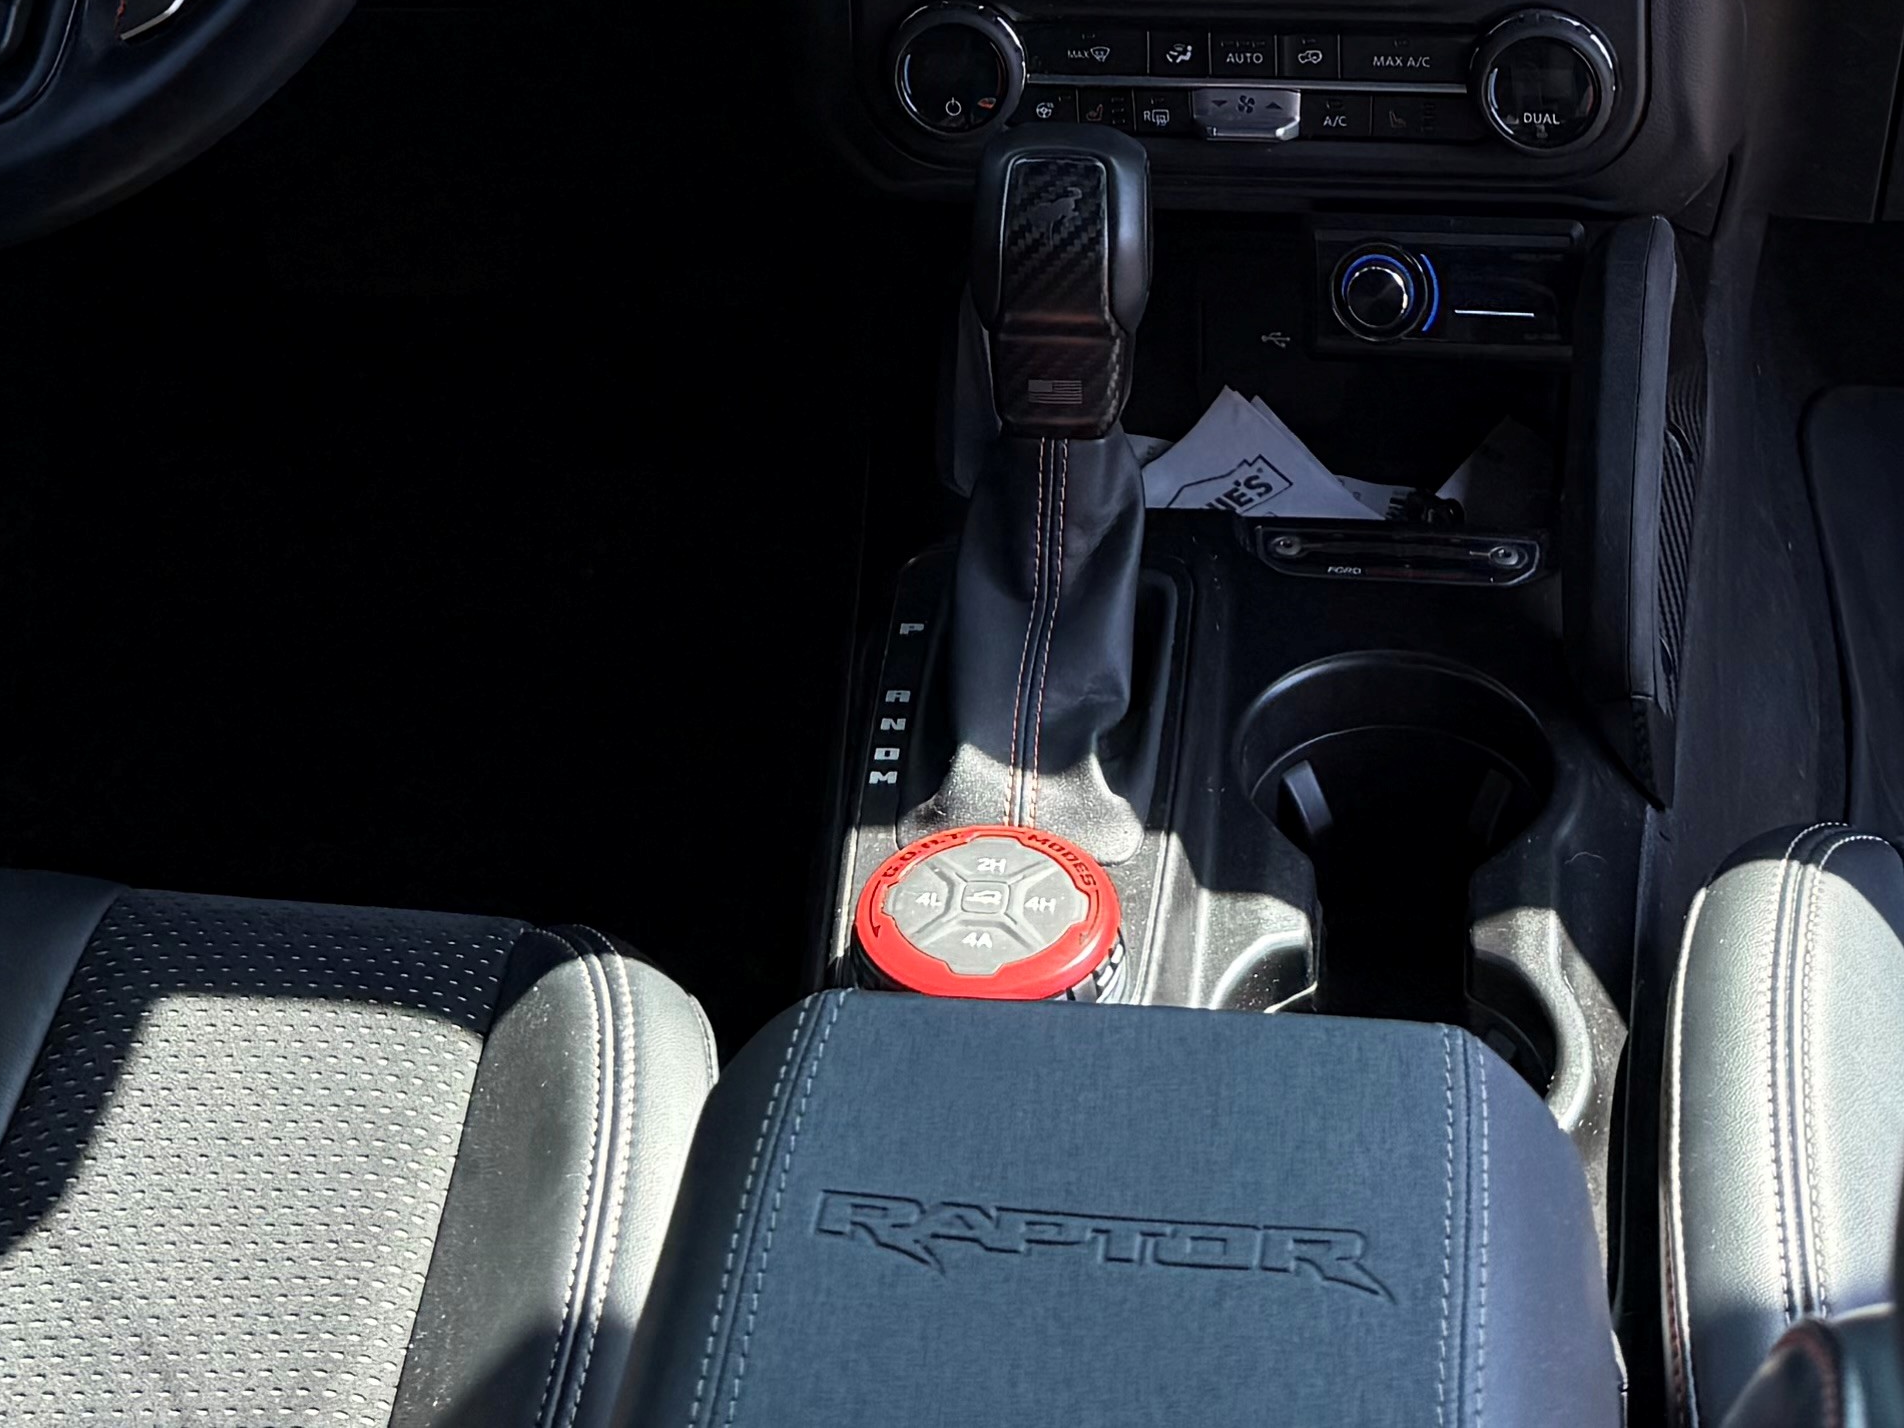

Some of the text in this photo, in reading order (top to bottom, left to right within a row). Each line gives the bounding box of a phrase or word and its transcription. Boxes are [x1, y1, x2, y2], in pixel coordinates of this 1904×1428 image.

[1226, 53, 1264, 64] AUTO
[1372, 56, 1431, 69] MAX A/C
[1323, 115, 1347, 127] A/C
[1523, 112, 1560, 125] DUAL
[899, 622, 925, 636] P
[880, 717, 906, 732] N
[869, 771, 897, 784] M
[976, 857, 1007, 874] 2H
[1027, 833, 1097, 887] MODES
[914, 892, 943, 908] 4L
[1024, 896, 1058, 913] 4H
[962, 931, 993, 948] 4A
[815, 1188, 1397, 1305] RAPTOR
